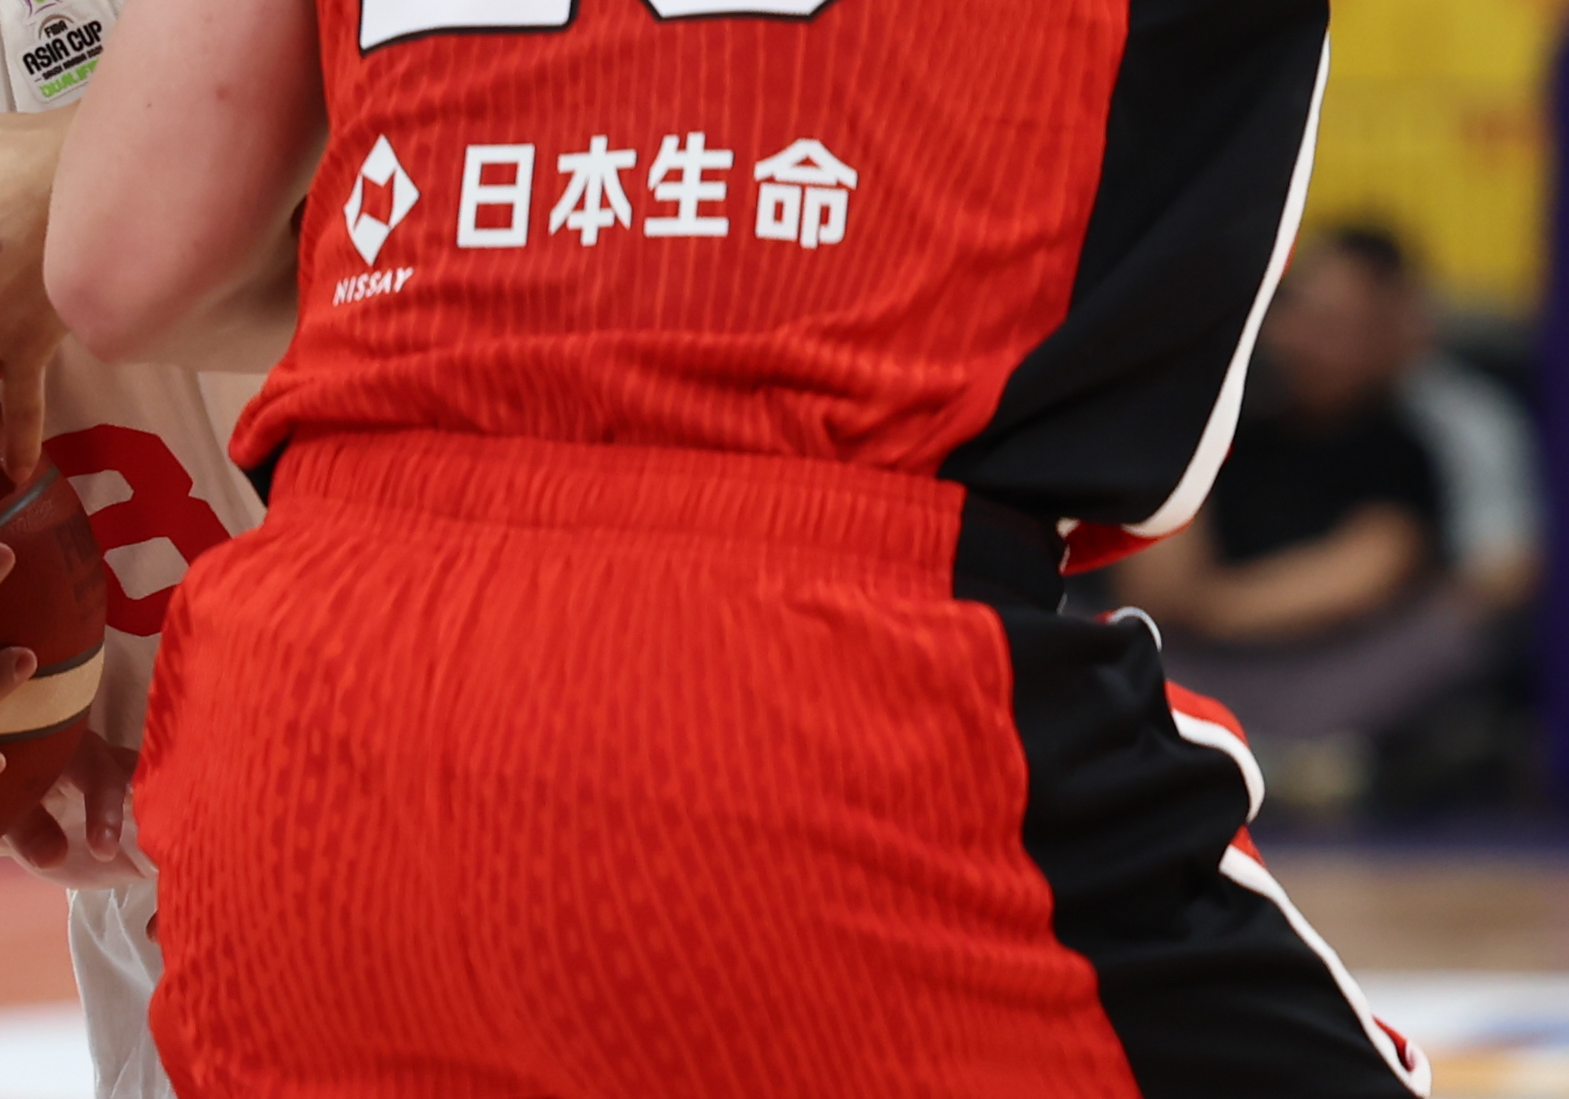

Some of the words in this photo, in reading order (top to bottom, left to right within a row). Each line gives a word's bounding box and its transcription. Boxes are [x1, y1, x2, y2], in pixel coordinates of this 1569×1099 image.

[22, 37, 71, 76] ASIA
[66, 19, 102, 52] CUP
[456, 131, 858, 249] 日本生命
[332, 266, 414, 307] NISSAY
